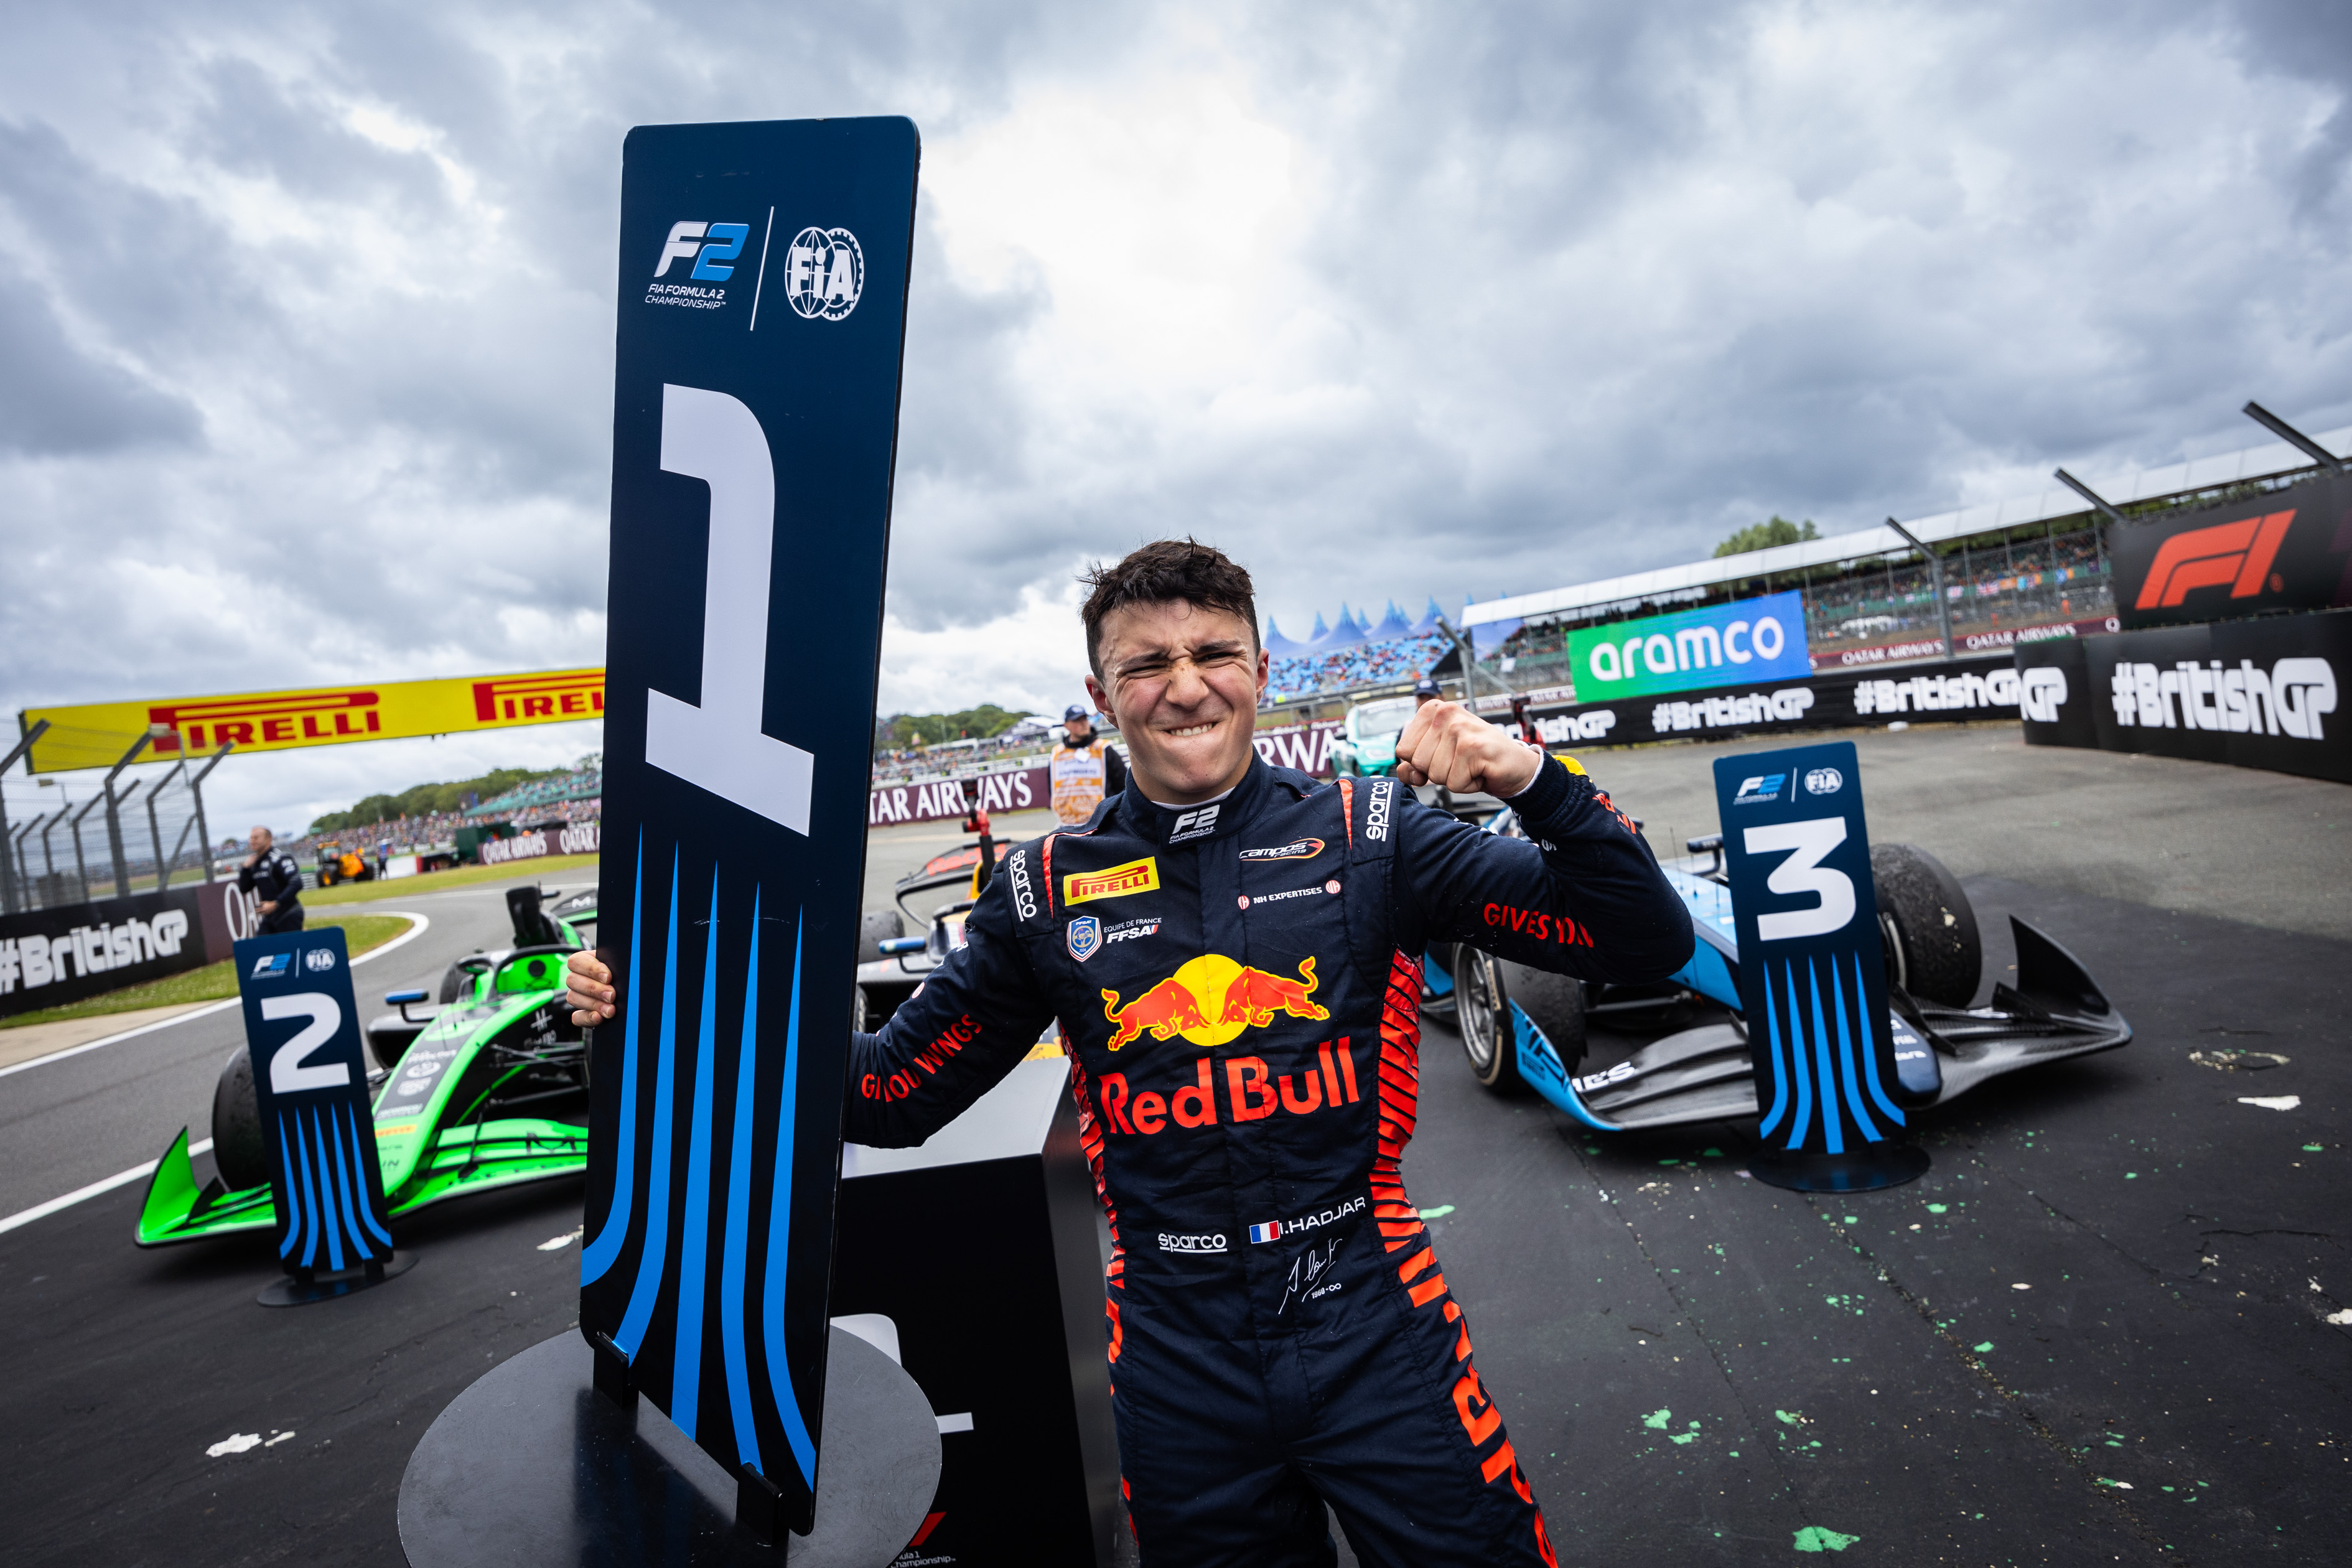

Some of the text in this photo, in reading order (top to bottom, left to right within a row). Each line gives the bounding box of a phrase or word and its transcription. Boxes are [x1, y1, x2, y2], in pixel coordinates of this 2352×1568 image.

[654, 221, 749, 281] F2
[648, 284, 726, 299] FIA FORMULA 2
[2134, 508, 2297, 611] F1
[645, 383, 783, 837] 1
[1589, 616, 1785, 682] aramco
[472, 673, 606, 723] PIREL
[1651, 687, 1814, 734] #BritishGP
[2111, 657, 2338, 740] #BritishGP
[149, 691, 380, 754] PIRELLI
[869, 788, 912, 824] TAR
[1737, 773, 1786, 797] F2
[1172, 805, 1220, 834] F2
[1180, 828, 1210, 838] FORMULA
[1366, 781, 1394, 842] sparco
[1274, 849, 1307, 858] racing
[1009, 849, 1037, 922] sparco
[1071, 865, 1149, 898] PIRELLI
[1253, 895, 1267, 904] NH
[1269, 887, 1323, 901] EXPERTISES
[1743, 816, 1857, 941] 3
[1104, 922, 1125, 933] EQUIPE
[1136, 917, 1162, 926] FRANCE
[1483, 903, 1551, 940] GIVES
[0, 908, 188, 997] #BritishGP
[251, 953, 292, 973] F2
[260, 992, 351, 1094] 2
[1098, 1035, 1360, 1135] Red Bull
[1279, 1196, 1366, 1235] I.HADJAR
[1158, 1233, 1228, 1253] sparco
[890, 1555, 952, 1568] hampionship
